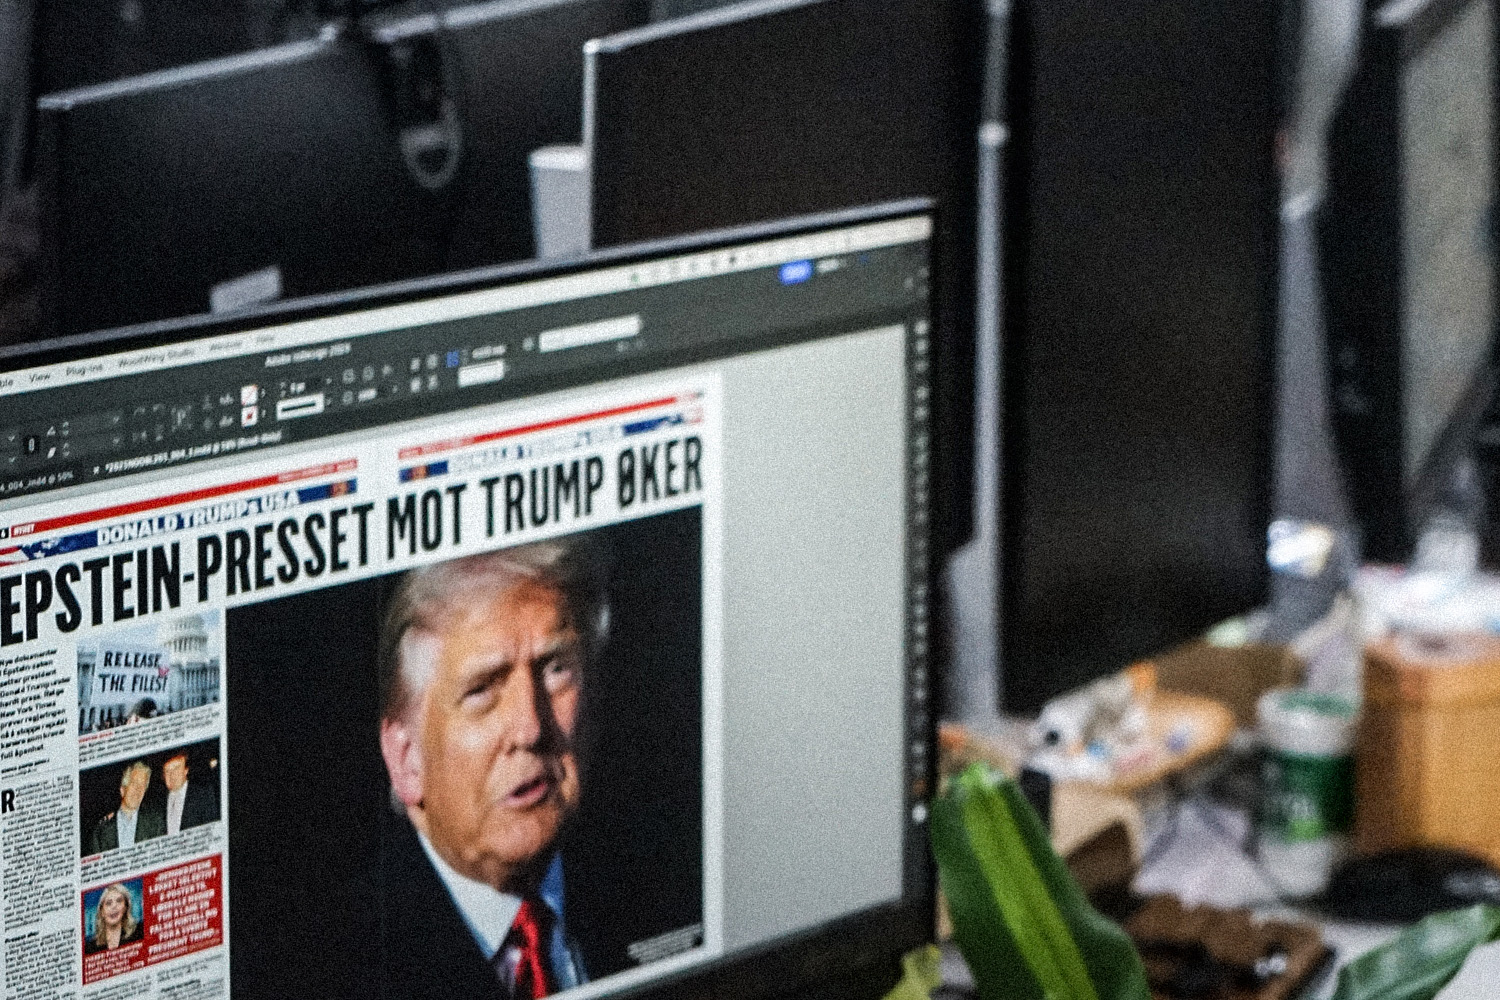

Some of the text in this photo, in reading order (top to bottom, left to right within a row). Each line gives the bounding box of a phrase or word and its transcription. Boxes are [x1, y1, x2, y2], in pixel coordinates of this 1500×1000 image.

[29, 373, 51, 383] View
[97, 515, 178, 546] DONALD
[261, 489, 301, 514] USA
[0, 502, 374, 646] EPSTEIN-PRESSET
[386, 484, 468, 560] MOT
[479, 455, 603, 538] TRUMP
[616, 435, 702, 508] ØKER
[103, 651, 162, 668] RELEASE
[22, 668, 56, 684] president
[98, 674, 125, 693] THE
[26, 680, 49, 693] Trump
[0, 699, 56, 718] New York Times
